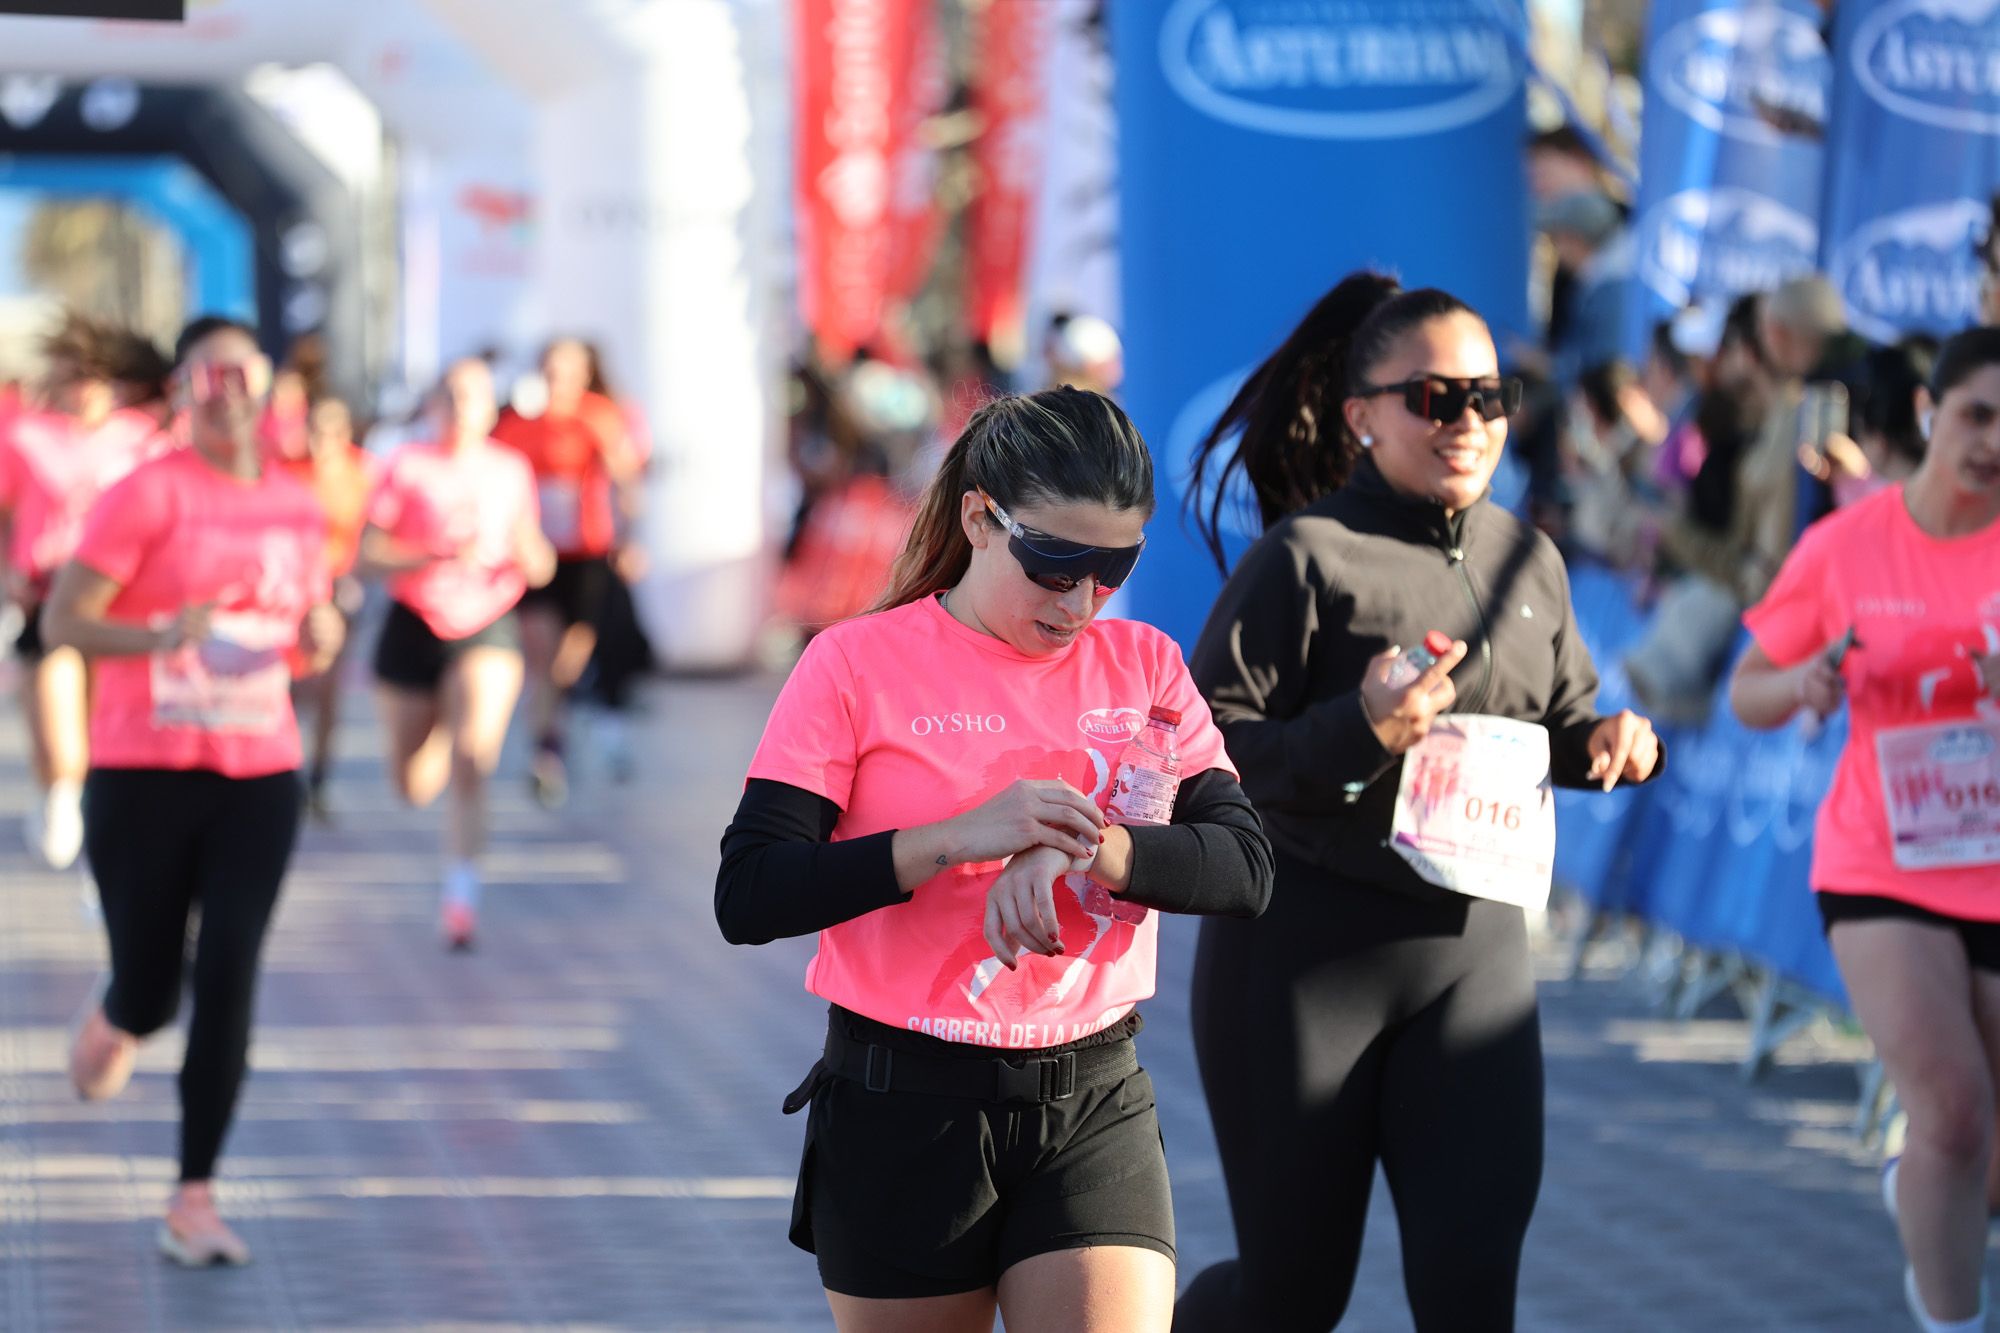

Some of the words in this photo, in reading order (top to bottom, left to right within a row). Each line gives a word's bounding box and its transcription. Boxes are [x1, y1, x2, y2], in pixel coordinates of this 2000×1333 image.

[911, 712, 1006, 736] OYSHO
[1464, 796, 1522, 831] 016
[907, 1016, 1003, 1047] CARRERA
[1009, 1023, 1036, 1048] DE
[1042, 1023, 1065, 1047] LA
